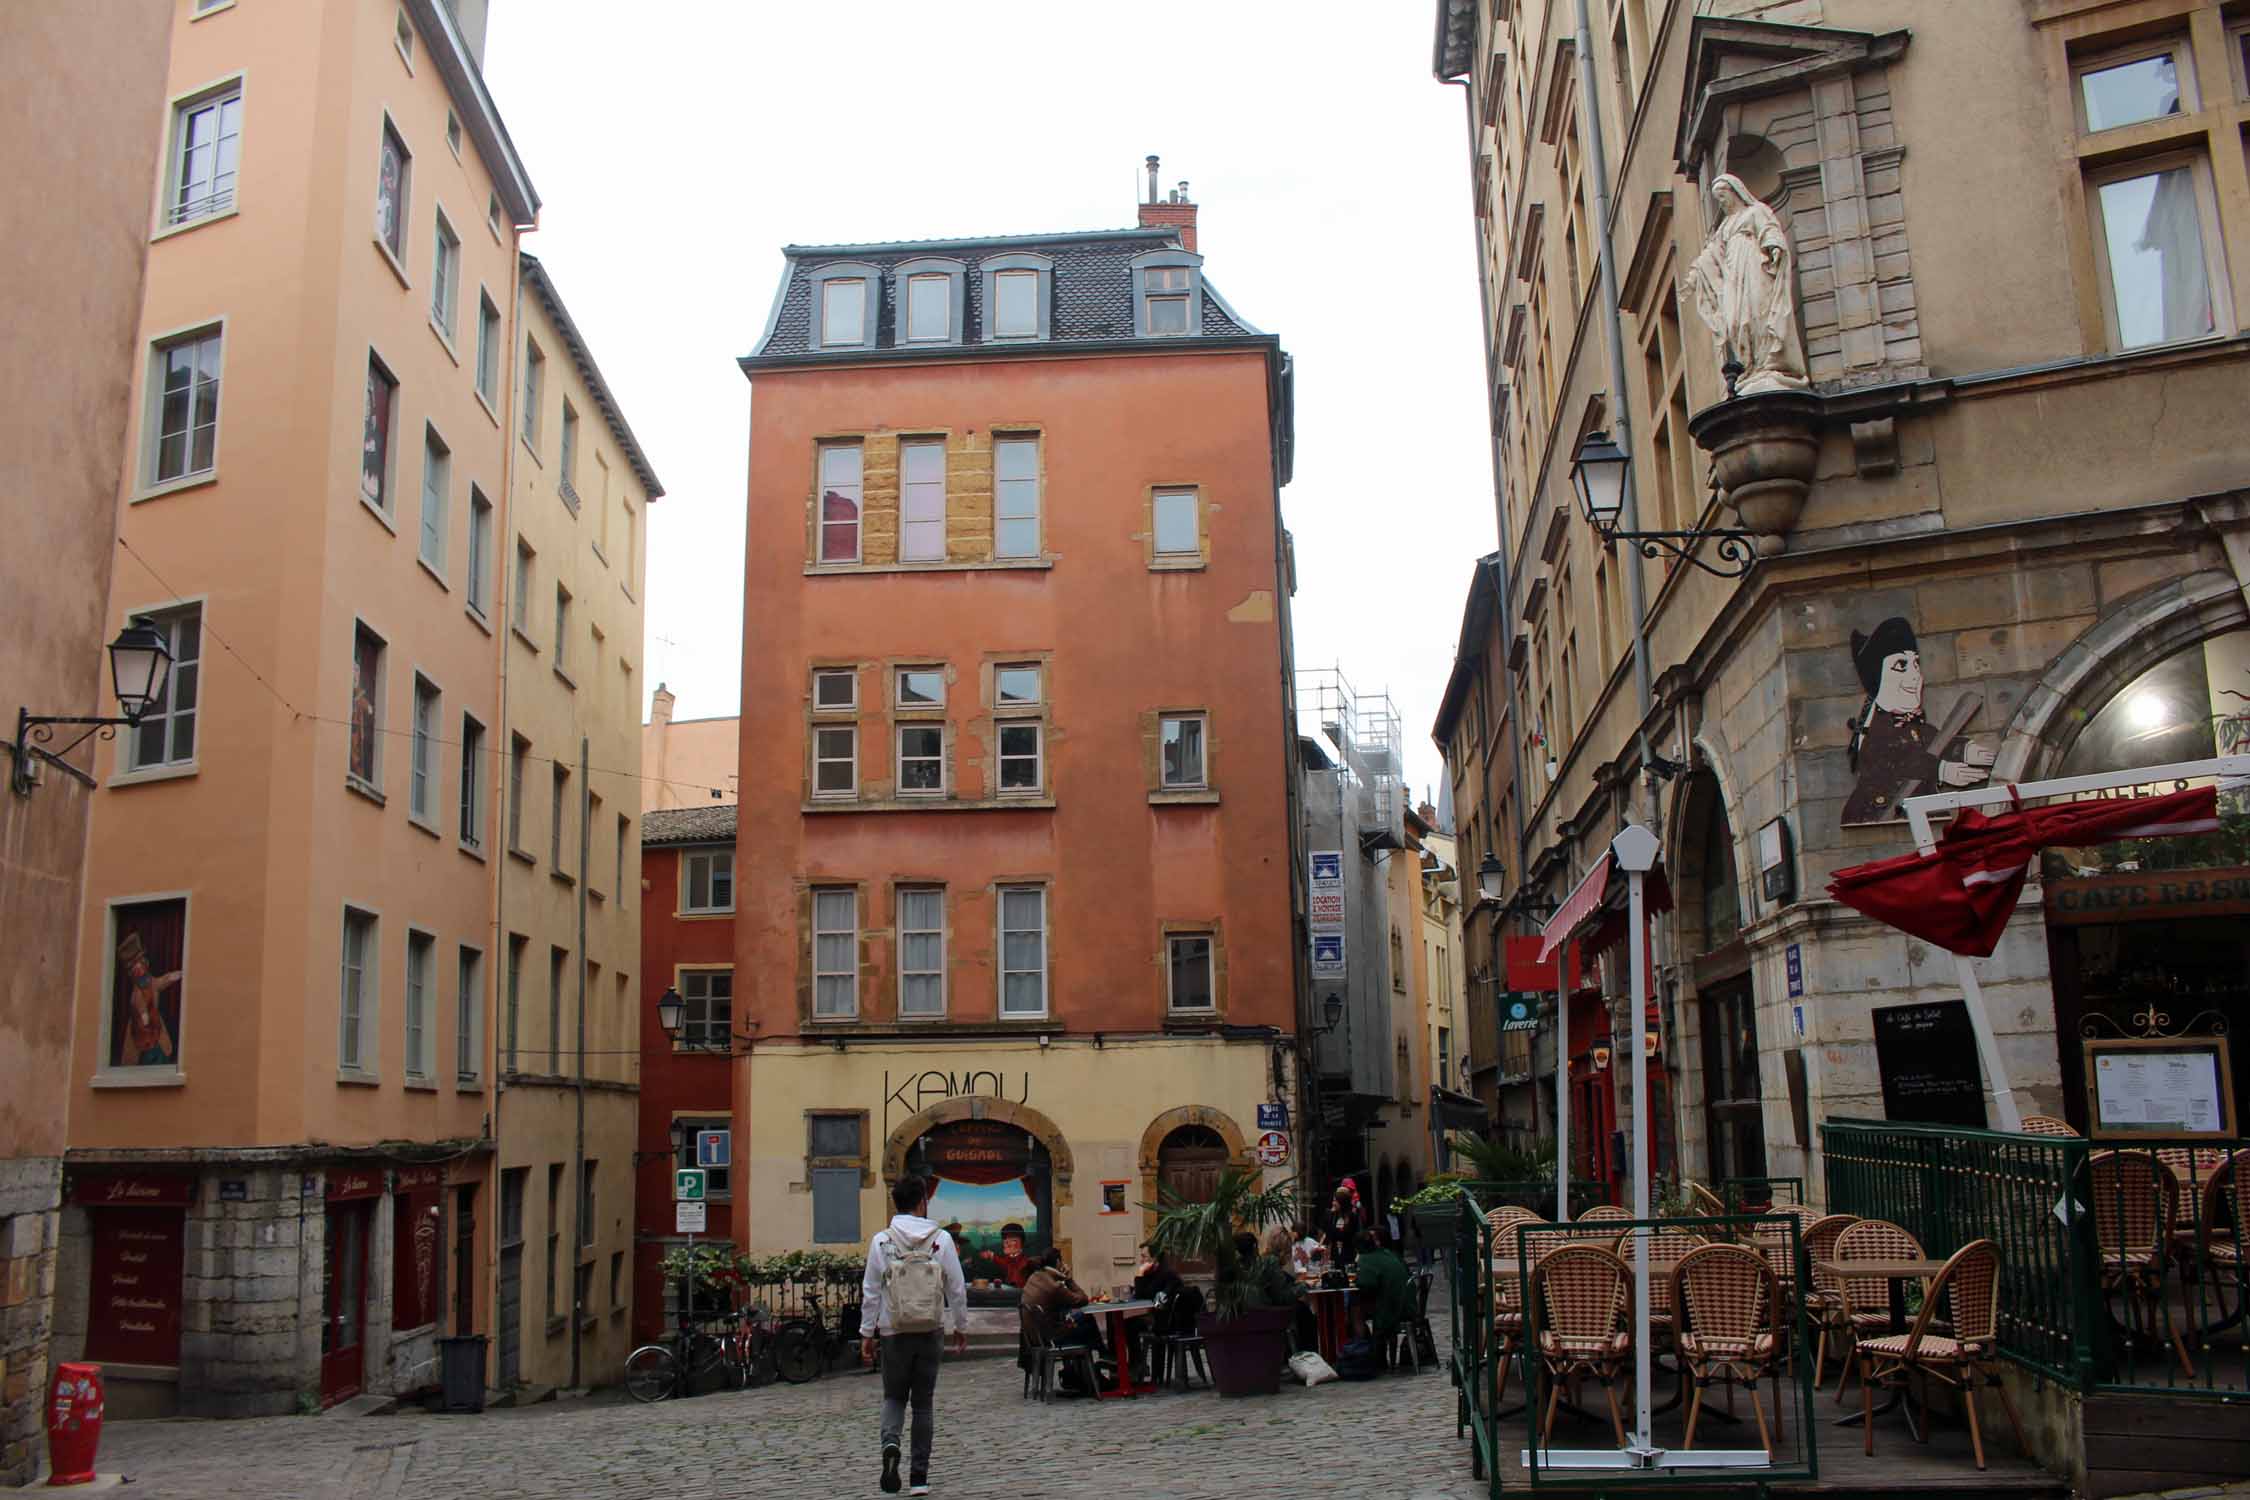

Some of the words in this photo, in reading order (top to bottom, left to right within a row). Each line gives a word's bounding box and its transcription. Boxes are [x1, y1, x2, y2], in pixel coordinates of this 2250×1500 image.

[1312, 895, 1341, 904] LOCATION
[1503, 1016, 1539, 1031] Laverie
[684, 1175, 697, 1192] P
